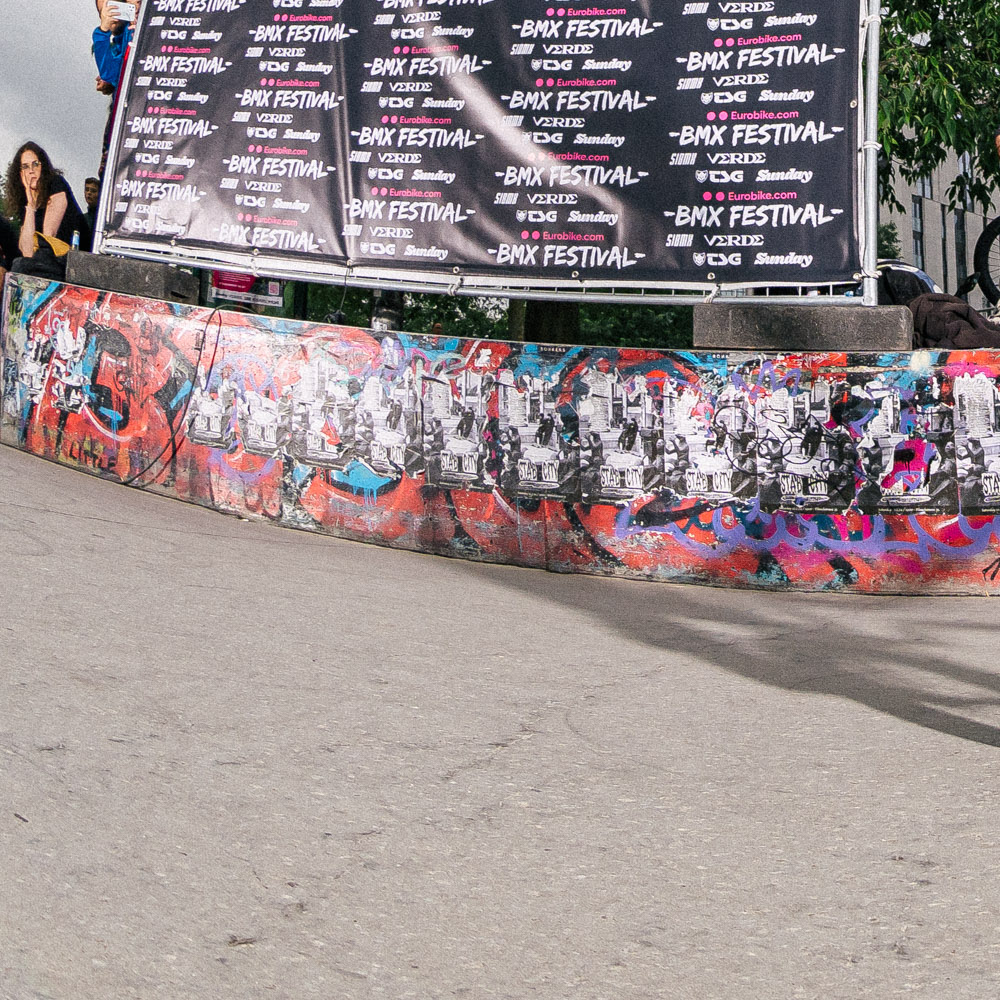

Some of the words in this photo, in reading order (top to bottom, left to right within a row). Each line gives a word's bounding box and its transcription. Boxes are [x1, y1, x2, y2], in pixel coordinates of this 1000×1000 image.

[568, 8, 626, 16] Eurobike.com
[764, 13, 817, 27] Sunday
[432, 26, 474, 38] Sunday
[737, 34, 802, 46] Eurobike.com
[411, 45, 459, 54] Eurobike.com
[582, 58, 632, 71] Sunday
[557, 78, 616, 86] Eurobike.com
[758, 89, 814, 102] Sunday
[422, 97, 464, 110] Sunday
[400, 116, 451, 124] Eurobike.com
[731, 110, 799, 120] Eurobike.com
[573, 133, 625, 147] Sunday
[549, 152, 609, 161] Eurobike.com
[411, 169, 455, 184] Sunday
[755, 168, 813, 183] Sunday
[390, 188, 441, 197] Eurobike.com
[728, 191, 797, 200] Eurobike.com
[567, 210, 618, 225] Sunday
[543, 232, 604, 240] Eurobike.com
[404, 245, 448, 260] Sunday
[754, 252, 813, 267] Sunday
